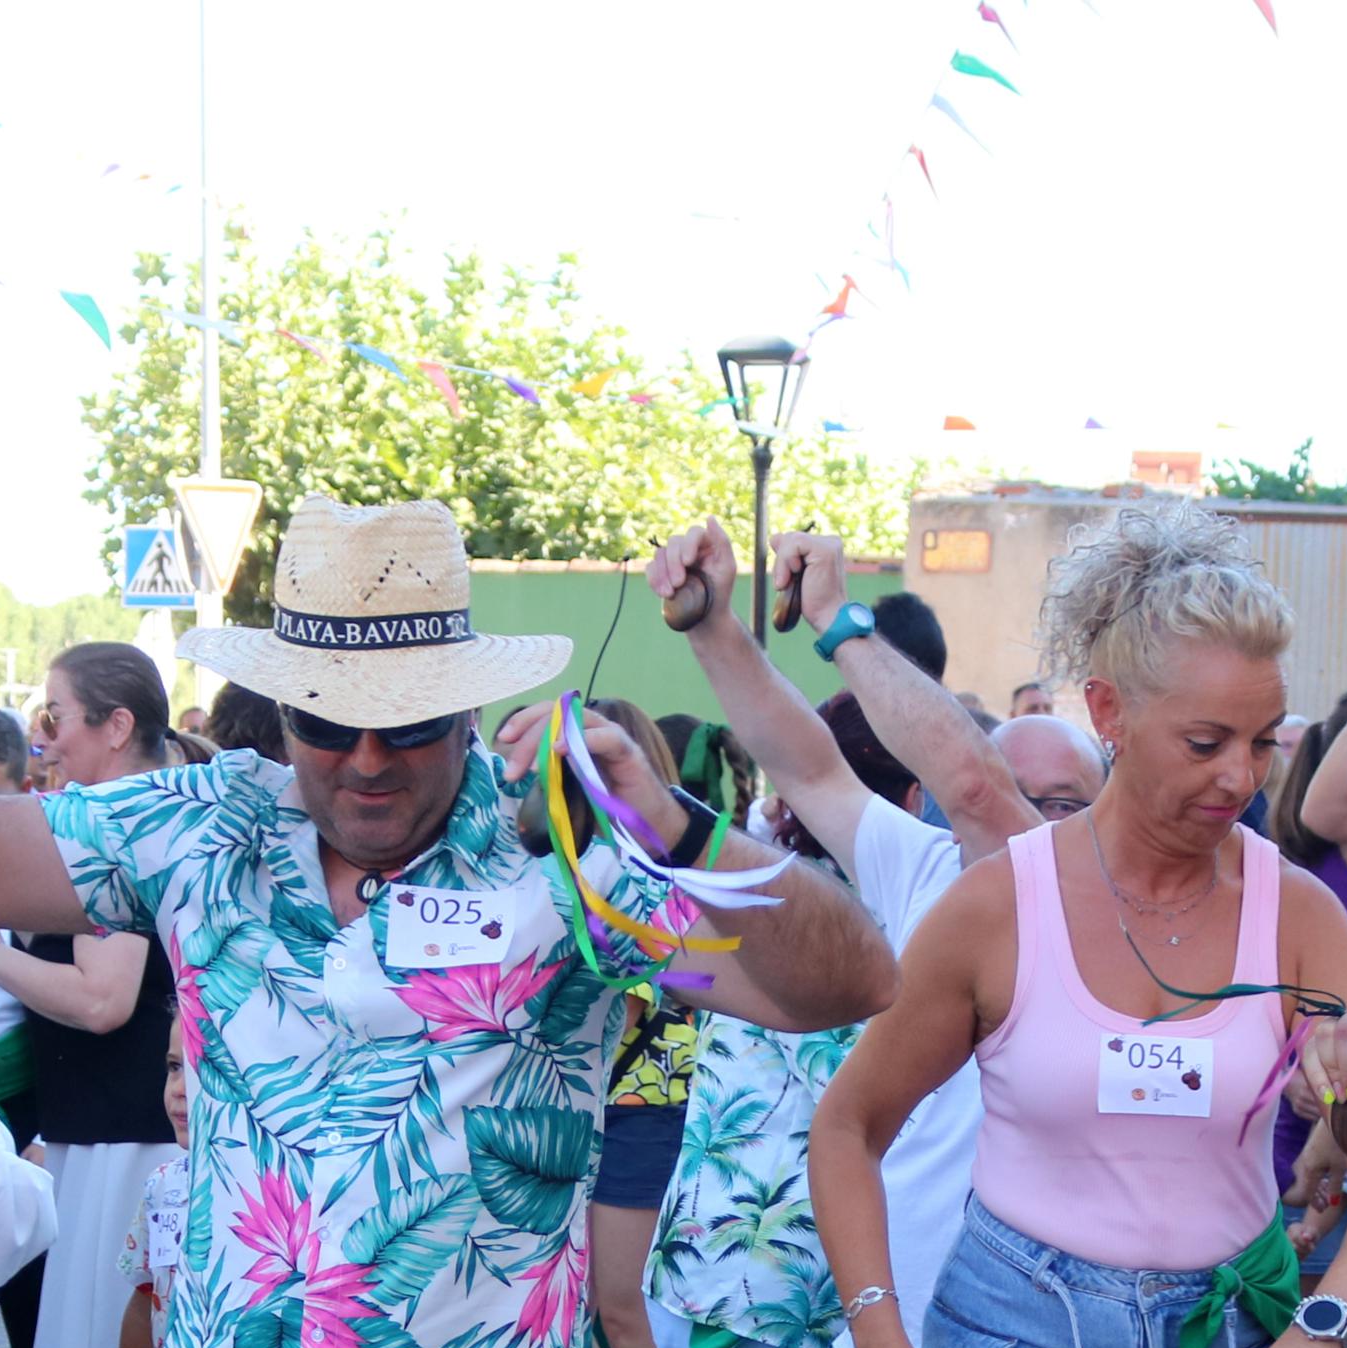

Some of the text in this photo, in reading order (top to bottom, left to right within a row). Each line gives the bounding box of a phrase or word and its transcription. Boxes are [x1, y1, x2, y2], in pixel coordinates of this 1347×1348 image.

[280, 613, 443, 644] PLAYA-BAVARO
[420, 897, 482, 924] 025
[1128, 1042, 1185, 1070] 054
